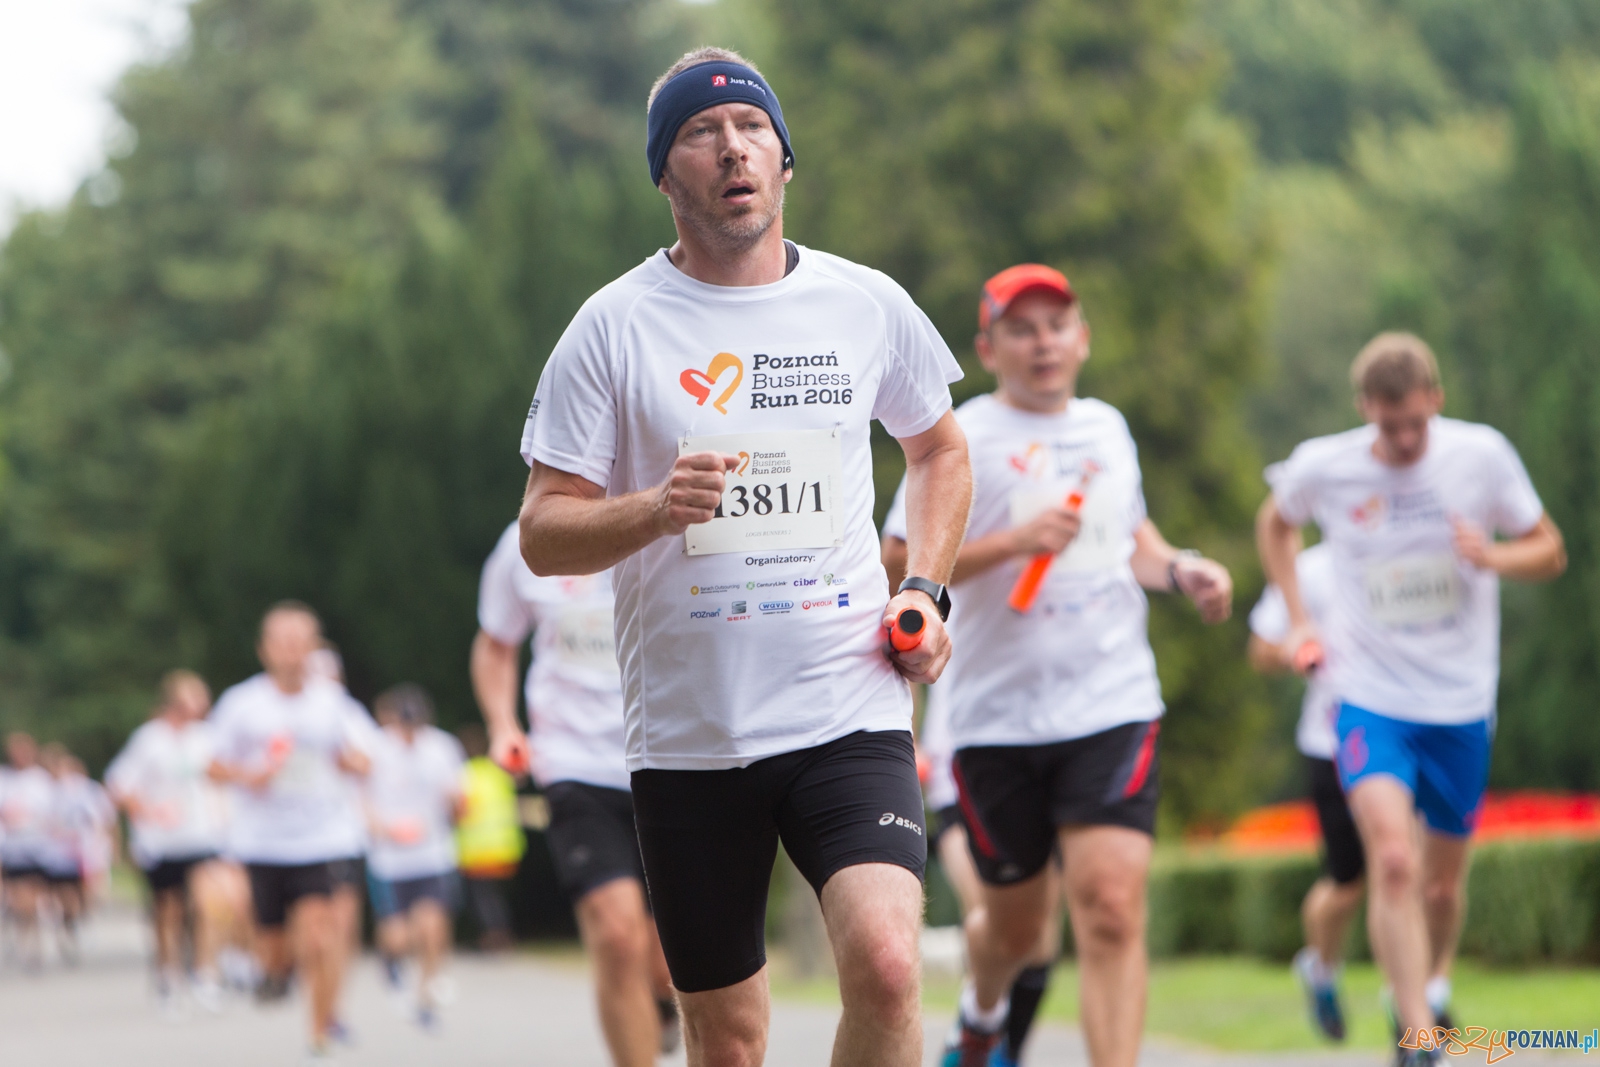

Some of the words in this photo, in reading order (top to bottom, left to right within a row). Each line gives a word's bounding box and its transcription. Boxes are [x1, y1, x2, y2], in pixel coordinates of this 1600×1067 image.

[753, 351, 838, 370] Poznań
[752, 371, 851, 390] Business
[750, 392, 799, 409] Run
[804, 388, 853, 405] 2016
[753, 451, 787, 459] Poznań
[752, 459, 791, 467] Business
[751, 467, 770, 475] Run
[771, 466, 792, 474] 2016
[745, 555, 816, 567] Organizatorzy:
[793, 578, 818, 587] ciber
[812, 600, 833, 608] VEOLIA
[895, 817, 922, 836] asics
